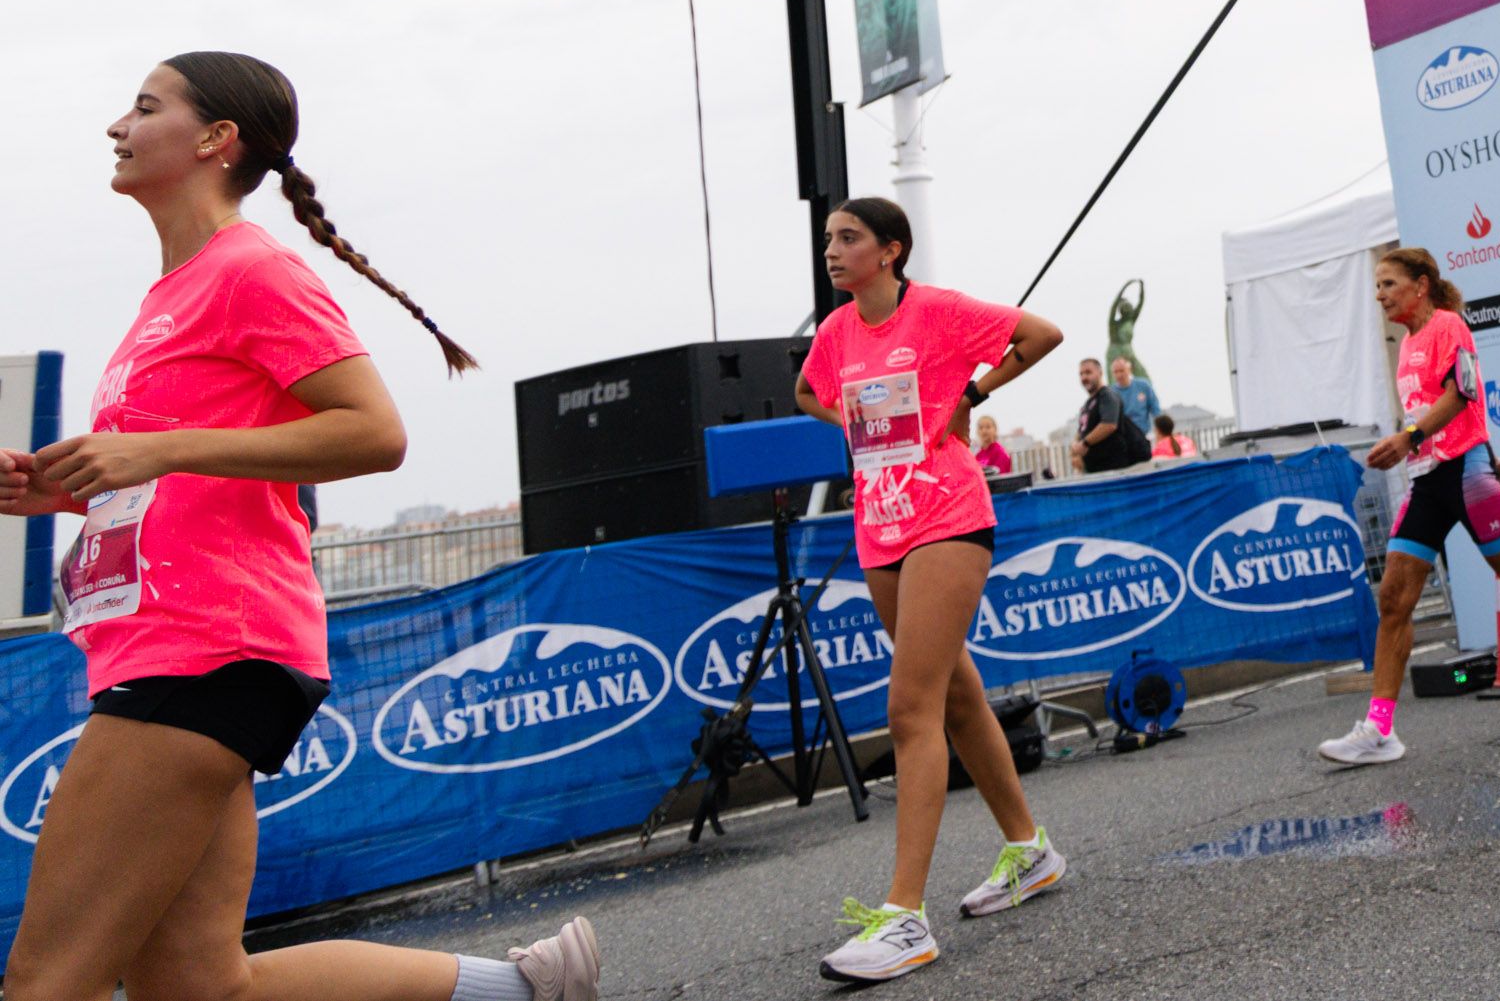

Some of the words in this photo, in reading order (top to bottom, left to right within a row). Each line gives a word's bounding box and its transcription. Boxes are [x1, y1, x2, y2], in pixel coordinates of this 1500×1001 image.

[1423, 65, 1495, 102] ASTURIANA
[866, 418, 892, 436] 016
[1233, 533, 1300, 556] CENTRAL
[1003, 575, 1079, 600] CENTRAL
[1085, 560, 1159, 585] LECHERA
[828, 611, 882, 631] LECH
[972, 575, 1173, 643] ASTURIANA
[444, 671, 538, 702] CENTRAL
[547, 650, 639, 680] LECHERA
[398, 668, 652, 755] ASTURIANA
